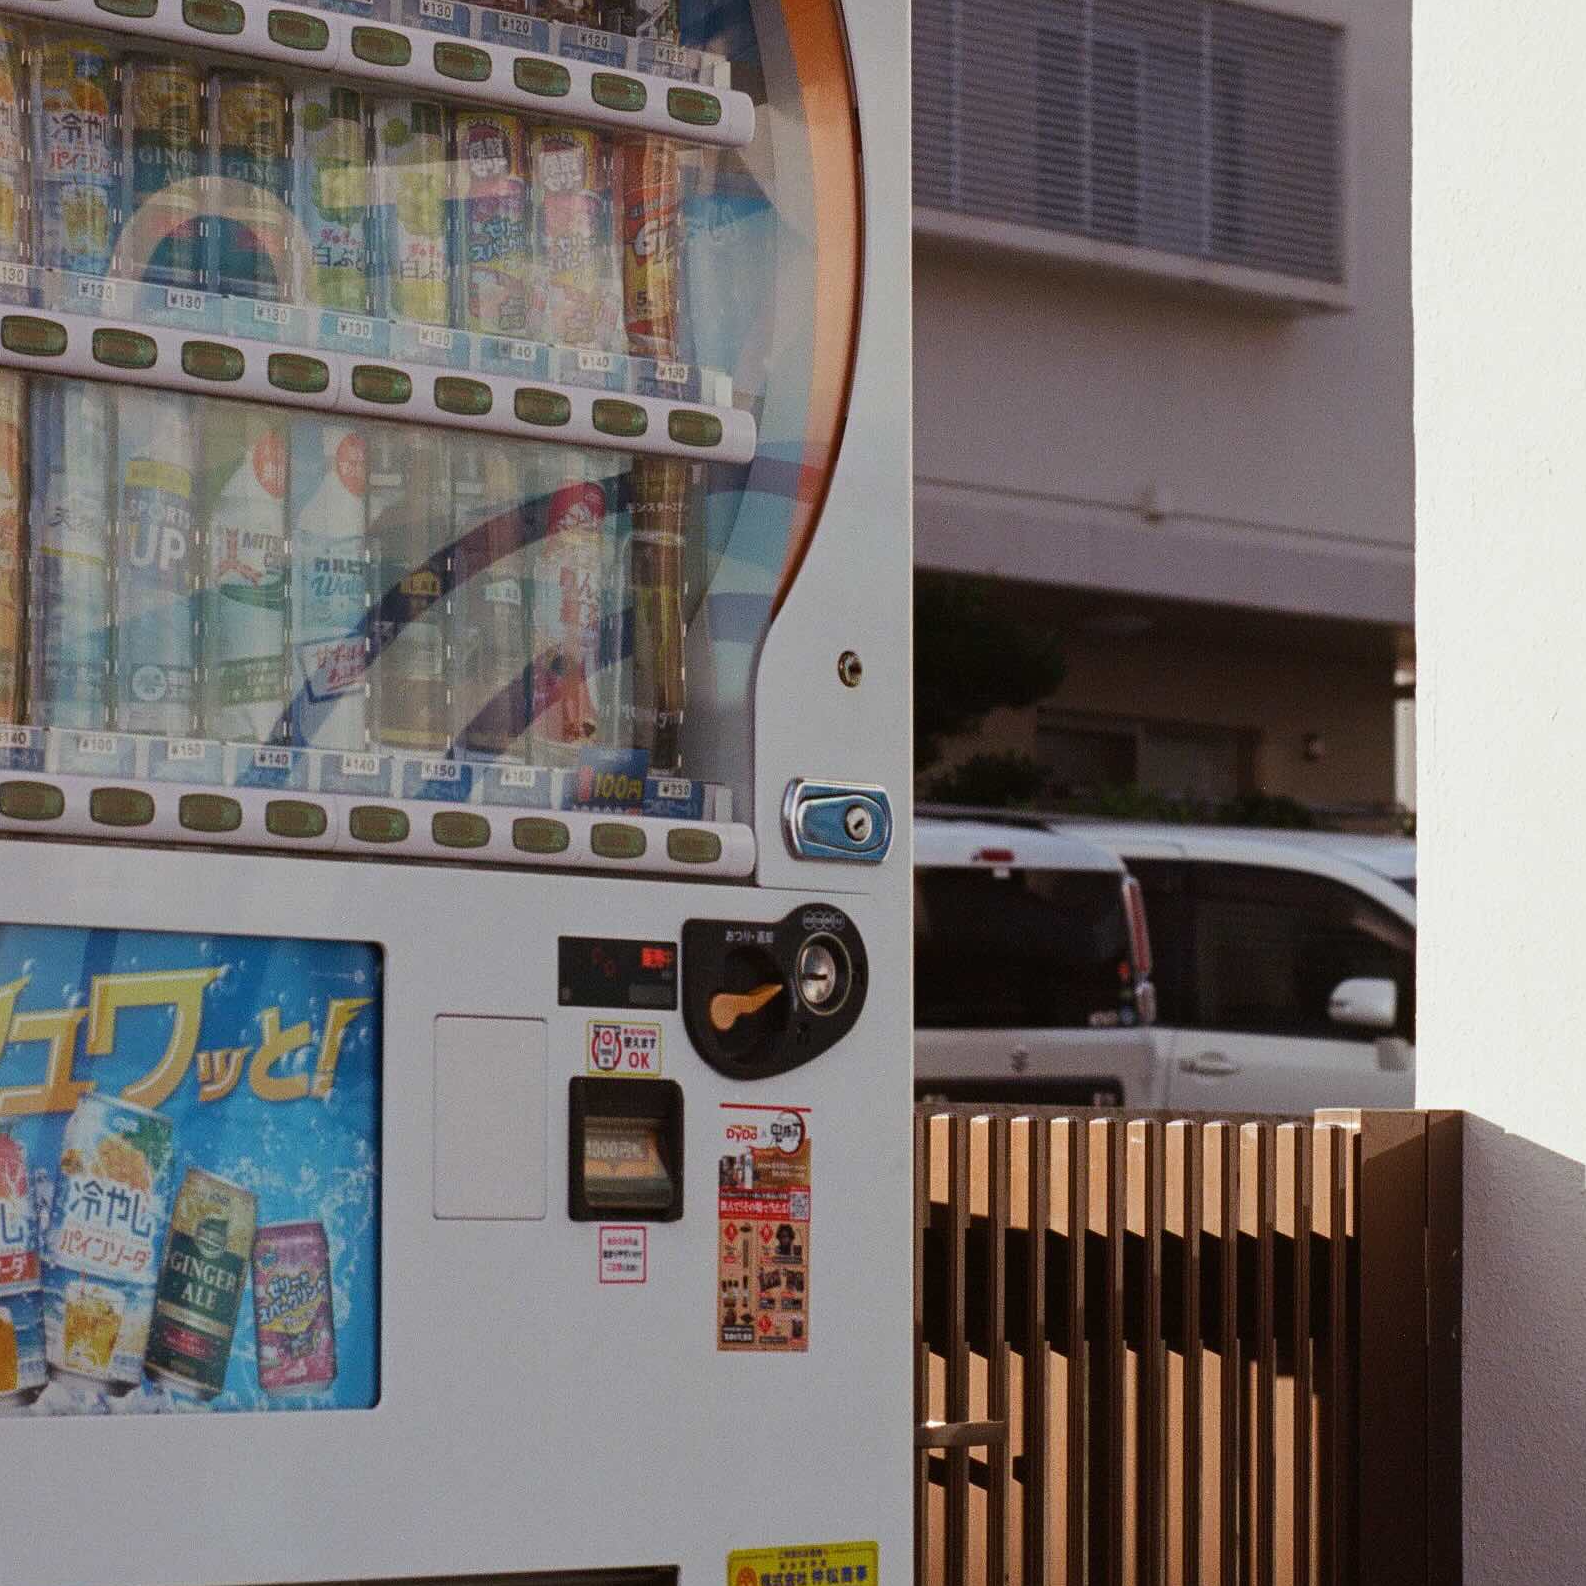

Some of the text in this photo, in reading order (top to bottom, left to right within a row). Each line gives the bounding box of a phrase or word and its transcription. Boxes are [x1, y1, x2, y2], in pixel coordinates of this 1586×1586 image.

[421, 2, 451, 19] ¥130
[501, 18, 530, 35] ¥120
[581, 33, 608, 49] ¥120
[170, 294, 201, 309] ¥130
[340, 321, 369, 337] ¥130
[628, 1051, 651, 1070] OK
[726, 1127, 758, 1143] DyDo
[69, 1179, 152, 1239] 冷やし
[60, 1229, 151, 1273] パインソーダ
[169, 1251, 238, 1294] GINGER
[180, 1281, 218, 1311] ALE
